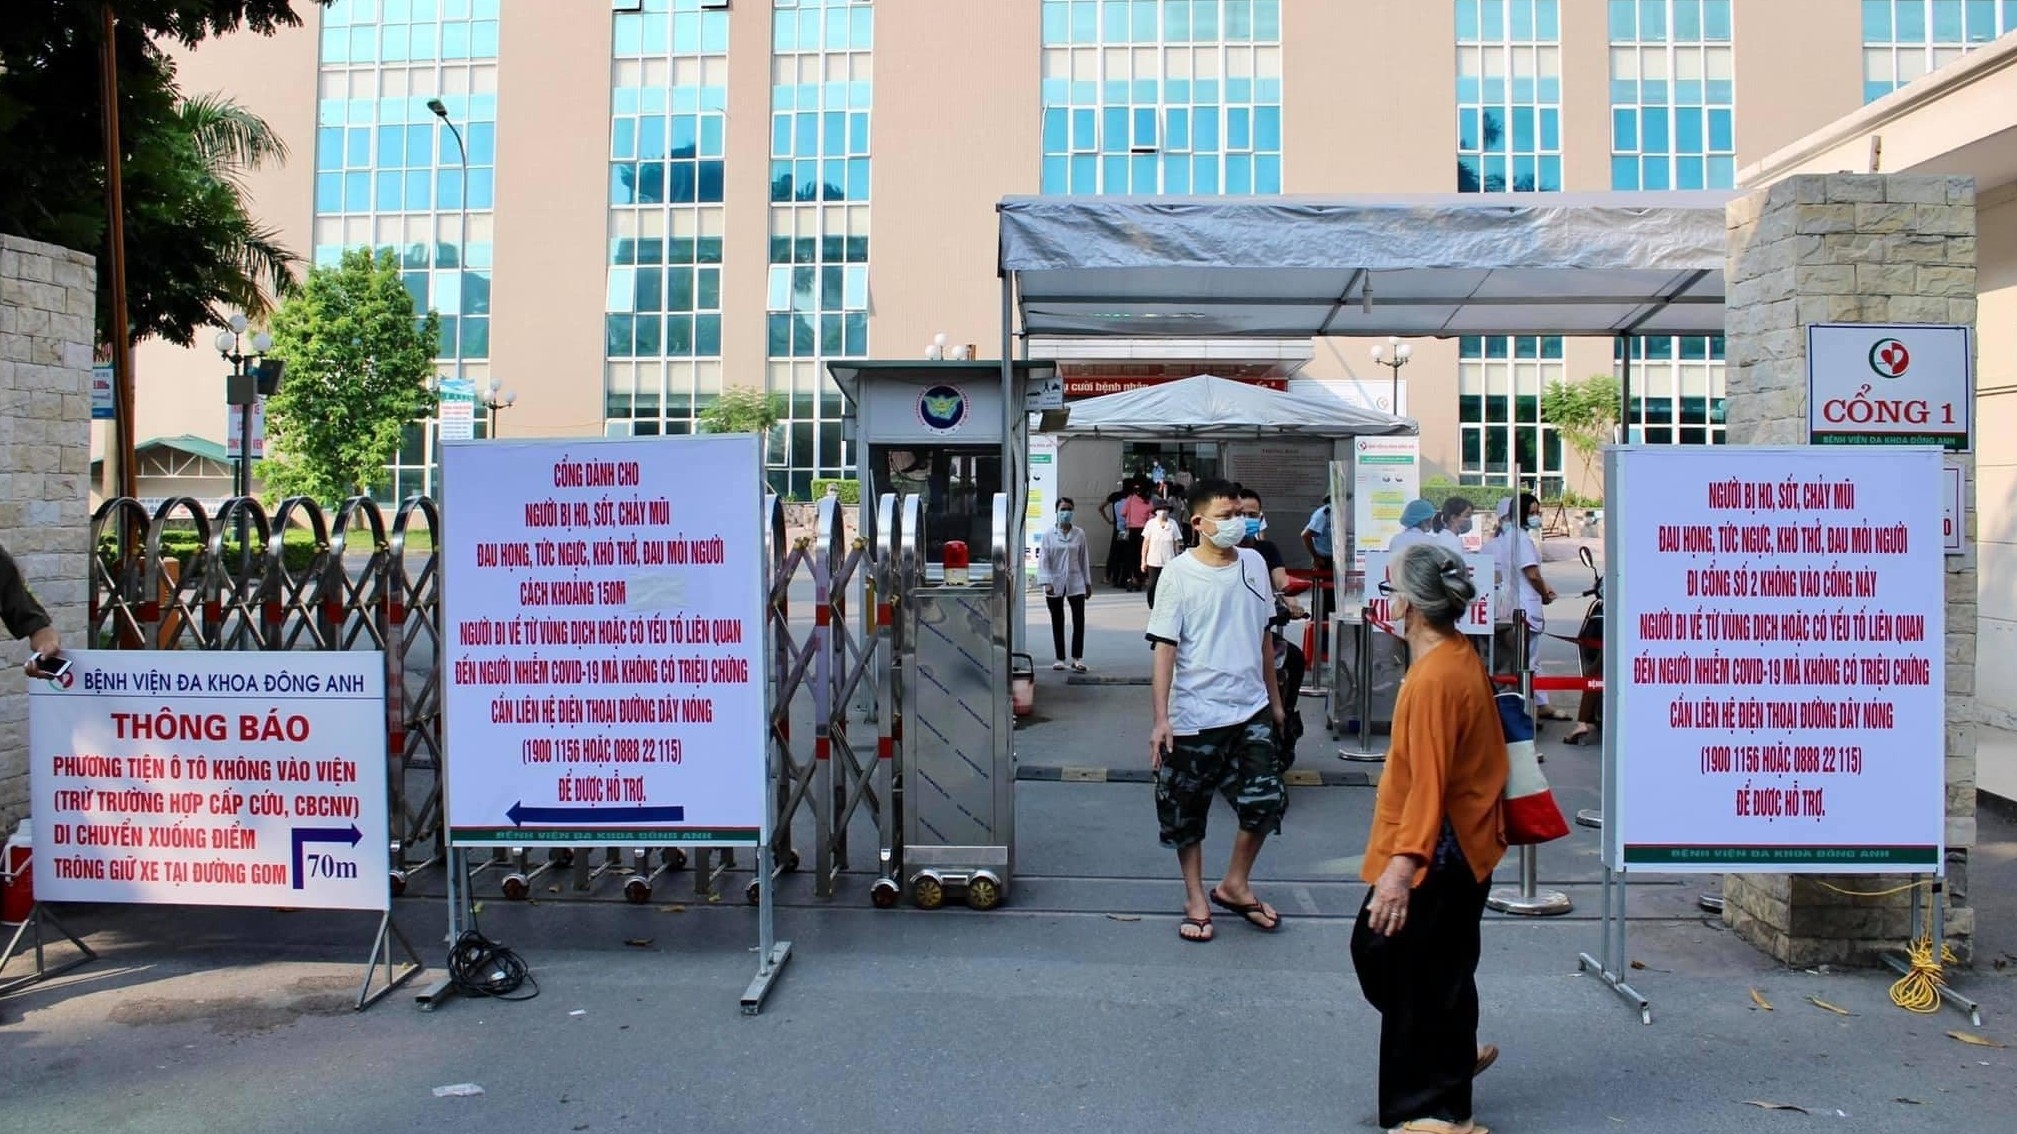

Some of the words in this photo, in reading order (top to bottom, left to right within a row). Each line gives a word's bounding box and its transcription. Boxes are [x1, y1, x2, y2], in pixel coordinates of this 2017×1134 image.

[1096, 381, 1121, 393] bệnh
[1824, 384, 1930, 424] CỔNG
[1941, 403, 1955, 423] 1
[554, 454, 582, 487] CỔNG
[586, 458, 614, 486] DÀNH
[618, 462, 638, 486] CHO
[1709, 476, 1741, 509] NGƯỜI
[1745, 483, 1755, 515] BỊ
[1759, 483, 1775, 512] HO,
[1779, 473, 1800, 512] SỐT,
[1804, 474, 1830, 509] CHẢY
[1834, 479, 1854, 509] MŨI
[526, 497, 557, 527] NGƯỜI
[561, 503, 571, 532] BỊ
[574, 502, 590, 529] HO,
[594, 493, 615, 527] SỐT,
[619, 493, 645, 525] CHẢY
[649, 497, 669, 525] MŨI
[477, 543, 497, 567] ĐAU
[501, 543, 532, 572] HỌNG,
[535, 537, 555, 566] TỨC
[558, 540, 590, 571] NGỰC,
[593, 537, 614, 565] KHÓ
[617, 533, 640, 567] THỞ,
[643, 541, 664, 565] ĐAU
[667, 532, 687, 564] MỎI
[691, 534, 723, 564] NGƯỜI
[1659, 526, 1680, 552] ĐAU
[1683, 526, 1715, 558] HỌNG,
[1718, 521, 1738, 553] TỨC
[1742, 524, 1773, 559] NGỰC,
[1777, 521, 1798, 553] KHÓ
[1801, 518, 1824, 555] THỞ,
[1828, 527, 1848, 553] ĐAU
[1852, 519, 1872, 553] MỎI
[1875, 521, 1907, 553] NGƯỜI
[520, 577, 548, 605] CÁCH
[551, 573, 594, 605] KHOẢNG
[597, 581, 625, 605] 150M
[1687, 570, 1698, 596] ĐI
[1702, 560, 1730, 596] CỔNG
[1734, 561, 1747, 597] SỐ
[1751, 571, 1757, 596] 2
[1761, 565, 1796, 597] KHÔNG
[1800, 565, 1820, 597] VÀO
[1824, 561, 1852, 597] CỔNG
[1856, 566, 1876, 597] NÀY
[460, 616, 492, 645] NGƯỜI
[495, 622, 505, 645] ĐI
[508, 614, 521, 645] VỀ
[524, 616, 538, 645] TỪ
[540, 617, 568, 645] VÙNG
[571, 621, 595, 649] DỊCH
[599, 616, 626, 649] HOẶC
[630, 615, 644, 644] CÓ
[647, 613, 667, 644] YẾU
[670, 611, 683, 643] TỐ
[686, 615, 709, 643] LIÊN
[713, 619, 741, 646] QUAN
[85, 668, 126, 694] BỆNH
[133, 669, 170, 694] VIỆN
[177, 674, 202, 691] ĐA
[208, 674, 258, 692] KHOA
[264, 670, 320, 692] ĐÔNG
[326, 675, 363, 692] ANH
[455, 654, 476, 684] ĐẾN
[479, 655, 511, 684] NGƯỜI
[514, 652, 548, 684] NHIỄM
[552, 660, 598, 684] COVID-19
[602, 655, 619, 683] MÀ
[622, 655, 657, 683] KHÔNG
[661, 655, 675, 683] CÓ
[678, 654, 708, 688] TRIỆU
[712, 654, 747, 683] CHỨNG
[111, 707, 226, 740] THÔNG
[240, 708, 309, 741] BÁO
[492, 692, 513, 723] CẦN
[516, 695, 539, 723] LIÊN
[542, 695, 555, 728] HỆ
[559, 695, 583, 728] ĐIỆN
[586, 699, 616, 728] THOẠI
[619, 693, 655, 723] ĐƯỜNG
[659, 694, 678, 723] DÂY
[682, 694, 712, 723] NÓNG
[1670, 693, 1692, 728] CẦN
[1696, 697, 1718, 728] LIÊN
[1722, 697, 1735, 734] HỆ
[1738, 697, 1763, 734] ĐIỆN
[1767, 702, 1797, 734] THOẠI
[1800, 696, 1836, 729] ĐƯỜNG
[1840, 697, 1860, 729] DÂY
[1864, 697, 1893, 729] NÓNG
[523, 739, 551, 765] (1900
[555, 739, 580, 762] 1156
[583, 735, 611, 767] HOẶC
[614, 739, 639, 762] 0888
[643, 739, 655, 762] 22
[659, 739, 681, 764] 115)
[1702, 746, 1730, 774] (1900
[1734, 746, 1759, 772] 1156
[1763, 741, 1790, 778] HOẶC
[1794, 747, 1819, 772] 0888
[1823, 747, 1835, 772] 22
[1839, 747, 1861, 775] 115)
[54, 756, 121, 777] PHƯƠNG
[127, 755, 164, 783] TIỆN
[171, 755, 181, 779] Ô
[186, 755, 207, 779] TÔ
[213, 756, 271, 781] KHÔNG
[277, 757, 310, 781] VÀO
[316, 757, 355, 786] VIỆN
[559, 769, 572, 801] ĐỂ
[575, 776, 603, 806] ĐƯỢC
[606, 770, 620, 801] HỖ
[623, 776, 646, 806] TRỢ.
[55, 787, 93, 812] (TRỪ
[97, 790, 163, 813] TRƯỜNG
[170, 792, 203, 818] HỢP
[210, 787, 243, 814] CẤP
[250, 789, 288, 818] CỨU,
[295, 796, 359, 819] CBCNV)
[1737, 779, 1750, 816] ĐỂ
[1753, 788, 1781, 822] ĐƯỢC
[1785, 781, 1799, 816] HỖ
[1802, 788, 1825, 822] TRỢ.
[54, 824, 70, 844] DI
[76, 818, 142, 846] CHUYỂN
[149, 820, 206, 848] XUỐNG
[212, 820, 255, 849] ĐIỂM
[54, 855, 104, 879] TRÔNG
[110, 856, 136, 881] GIỮ
[140, 861, 159, 881] XE
[164, 862, 187, 886] TẠI
[193, 858, 245, 883] ĐƯỜNG
[251, 864, 286, 884] GOM
[308, 855, 357, 878] 70m
